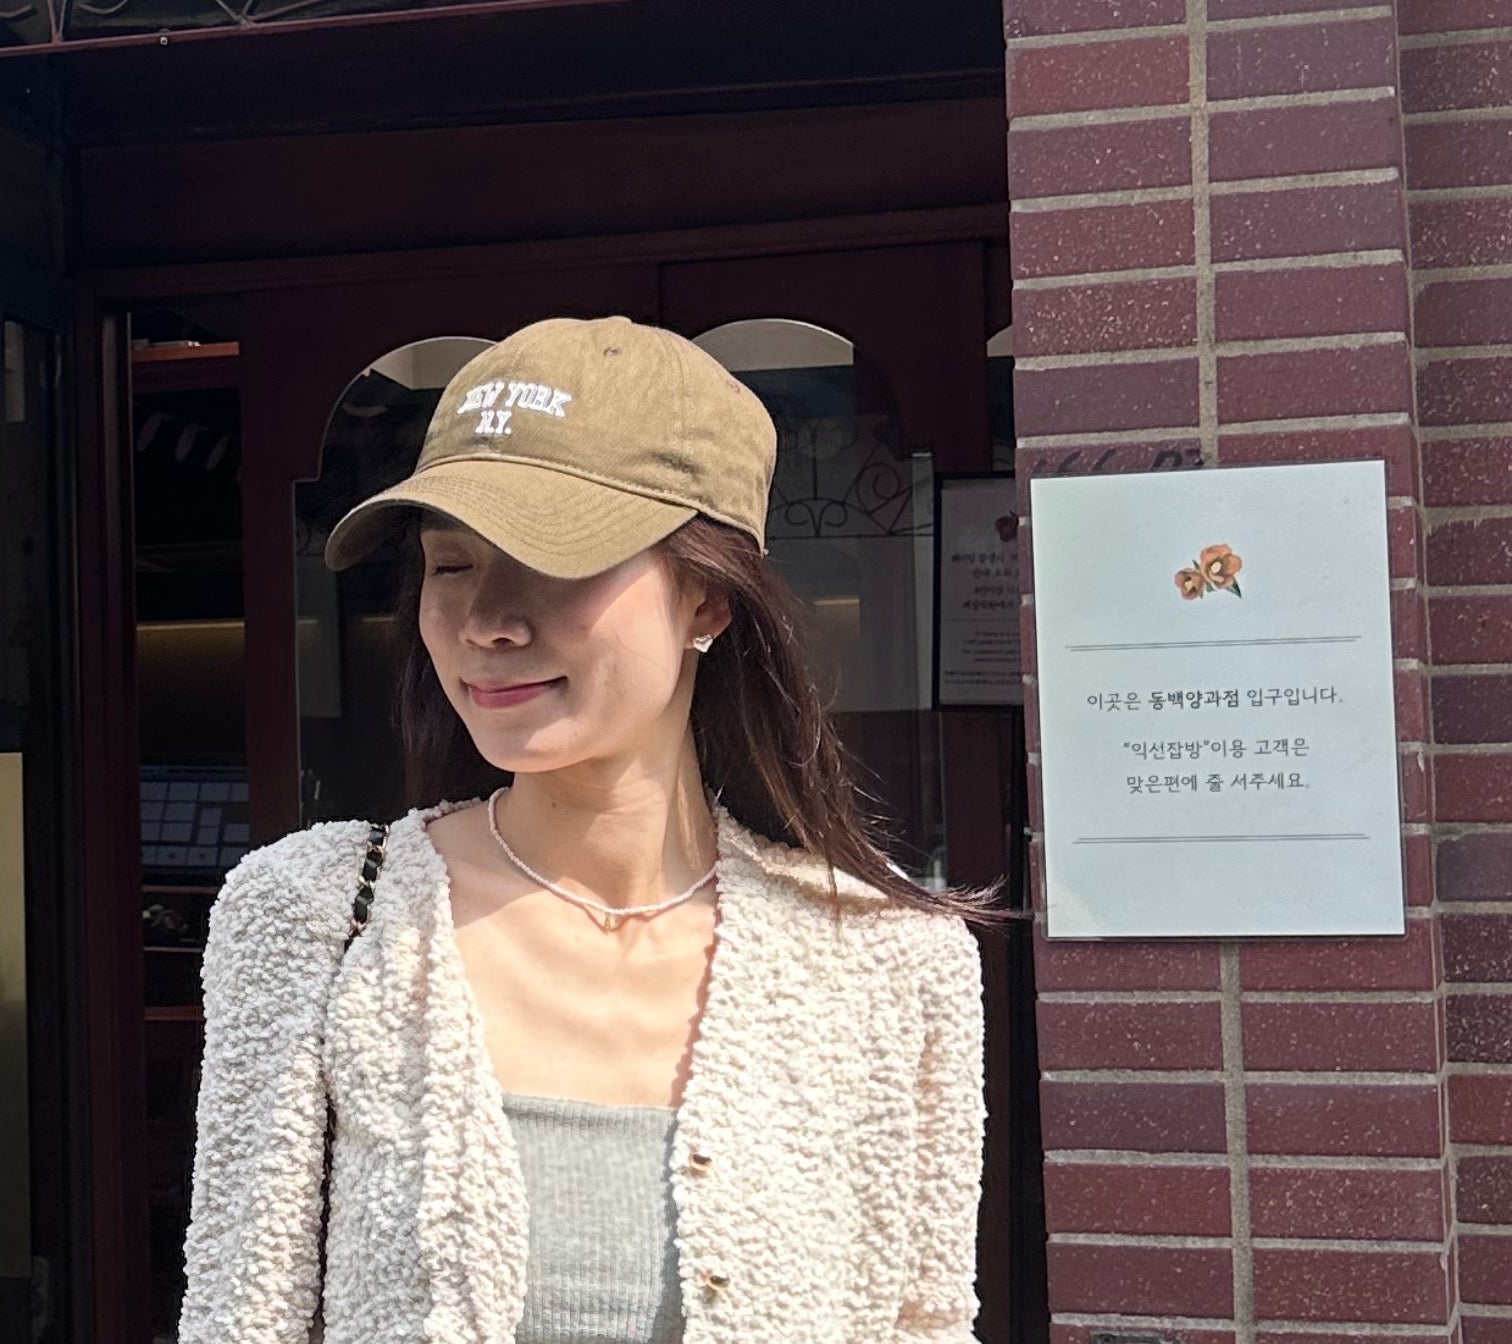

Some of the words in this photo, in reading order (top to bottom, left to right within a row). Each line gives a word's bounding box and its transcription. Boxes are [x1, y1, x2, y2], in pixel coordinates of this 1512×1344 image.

[505, 382, 572, 417] YORK
[1086, 692, 1142, 712] 이곳은
[1147, 688, 1240, 711] 동백양과점
[1246, 686, 1344, 706] 입구입니다.
[1253, 737, 1310, 757] 고객은
[1126, 774, 1198, 794] 맞은편에
[1205, 773, 1224, 793] 줄
[1230, 772, 1310, 791] 서주세요.
